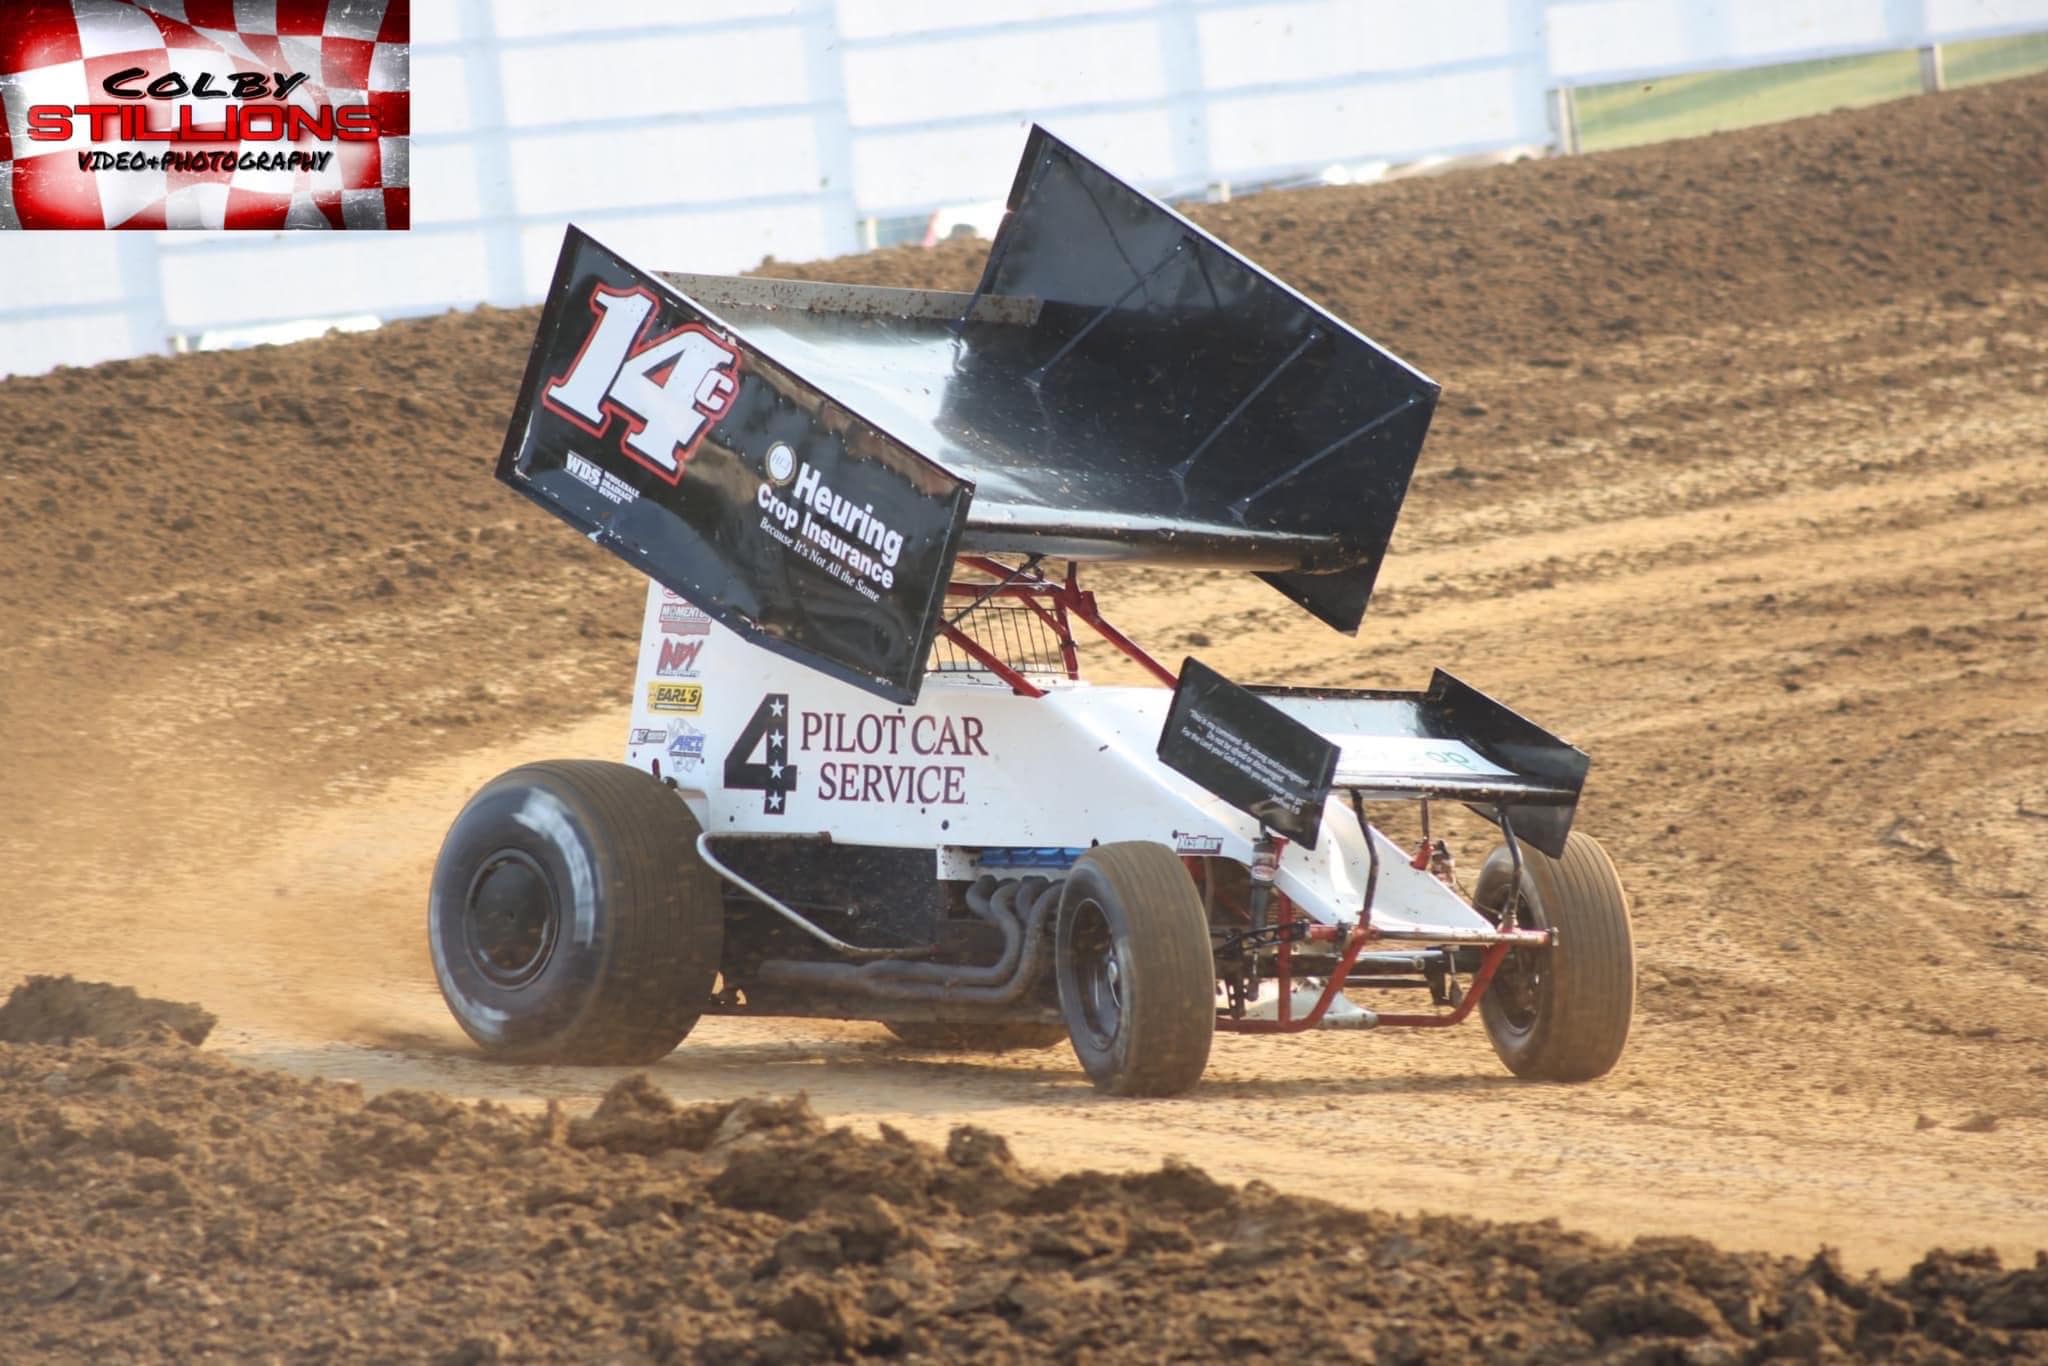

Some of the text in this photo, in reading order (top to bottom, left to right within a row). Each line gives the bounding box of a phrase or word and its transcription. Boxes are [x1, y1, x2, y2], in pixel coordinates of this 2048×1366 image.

[565, 453, 602, 486] WDS
[758, 483, 894, 588] Crop Insurance
[793, 462, 904, 567] Heuring
[760, 516, 794, 548] Because
[808, 550, 827, 569] Not
[826, 559, 841, 577] All
[840, 571, 857, 588] the
[855, 579, 880, 602] Same
[656, 688, 699, 703] EARL'S
[724, 692, 797, 815] 4
[801, 711, 989, 756] PILOT CAR
[818, 762, 967, 804] SERVICE
